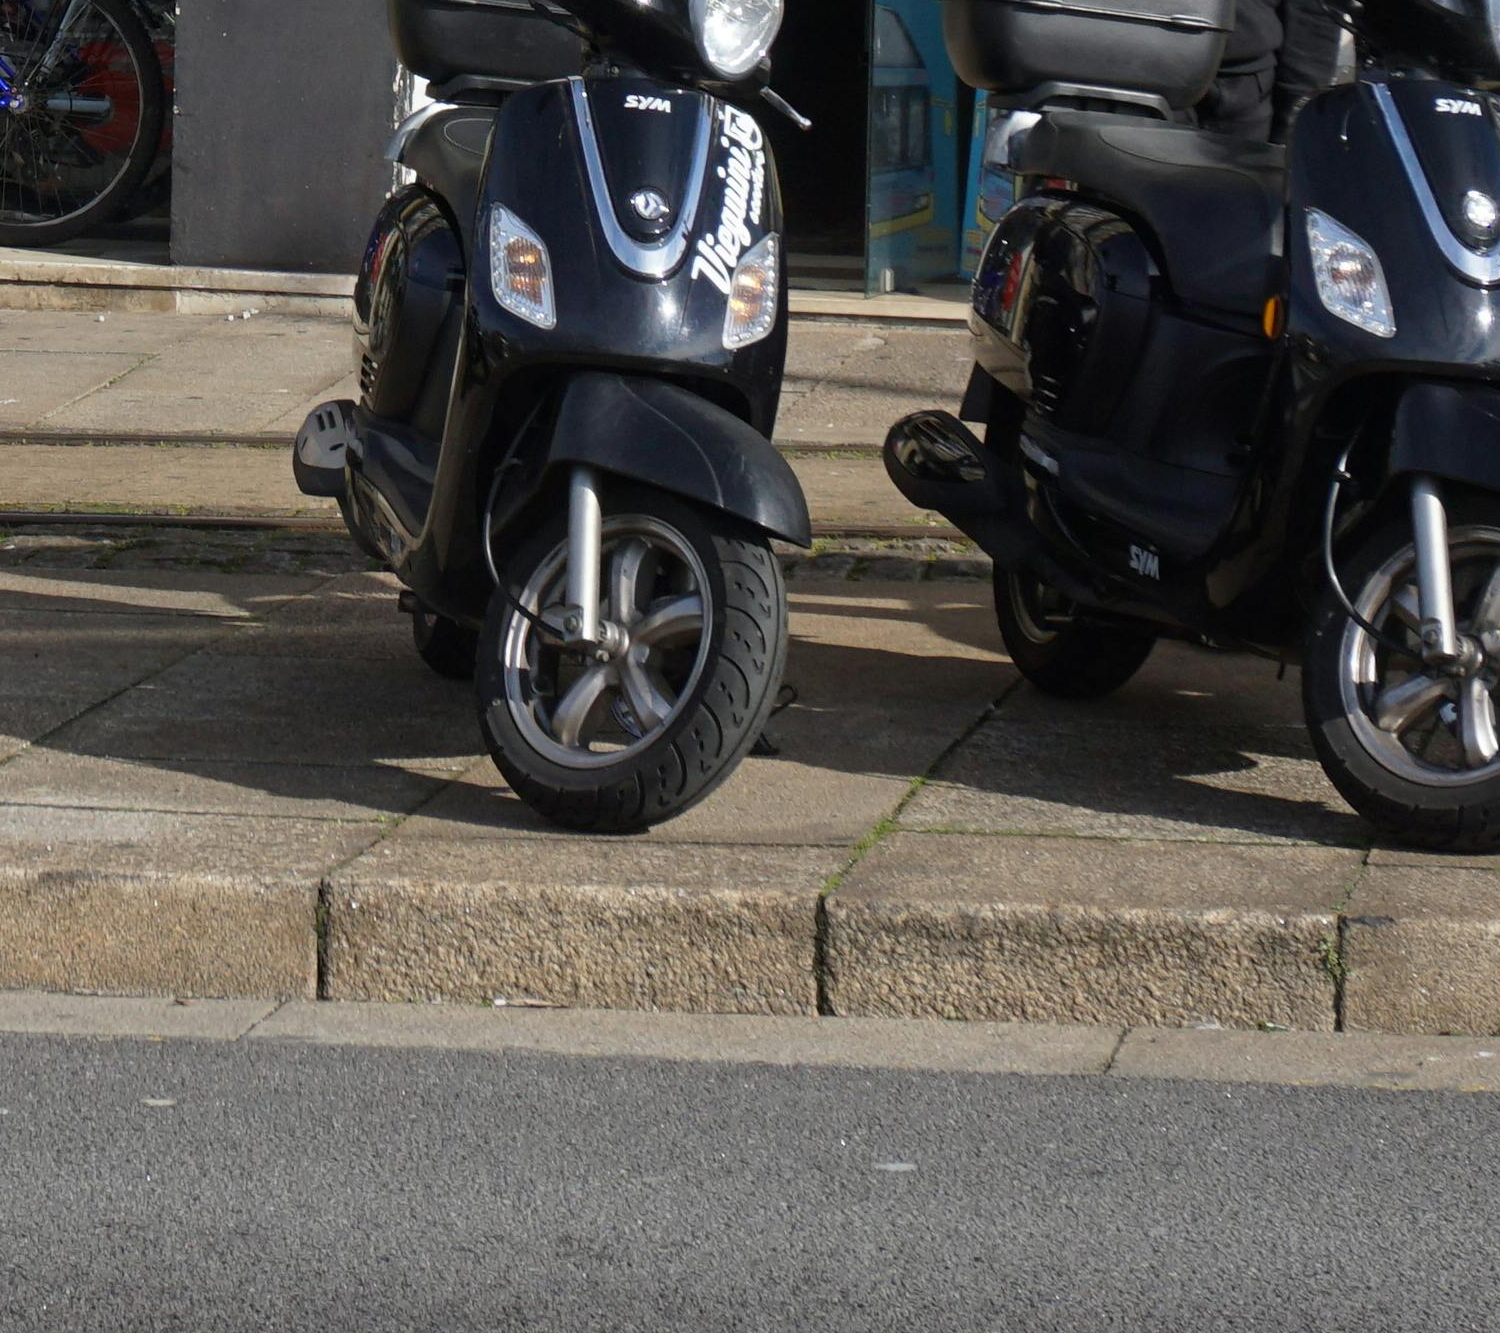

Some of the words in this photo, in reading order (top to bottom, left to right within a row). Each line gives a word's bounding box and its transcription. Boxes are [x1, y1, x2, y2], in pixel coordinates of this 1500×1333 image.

[623, 94, 672, 114] SYM
[1434, 97, 1483, 117] SYM
[690, 135, 752, 295] Vieguini
[1129, 544, 1161, 581] SYM
